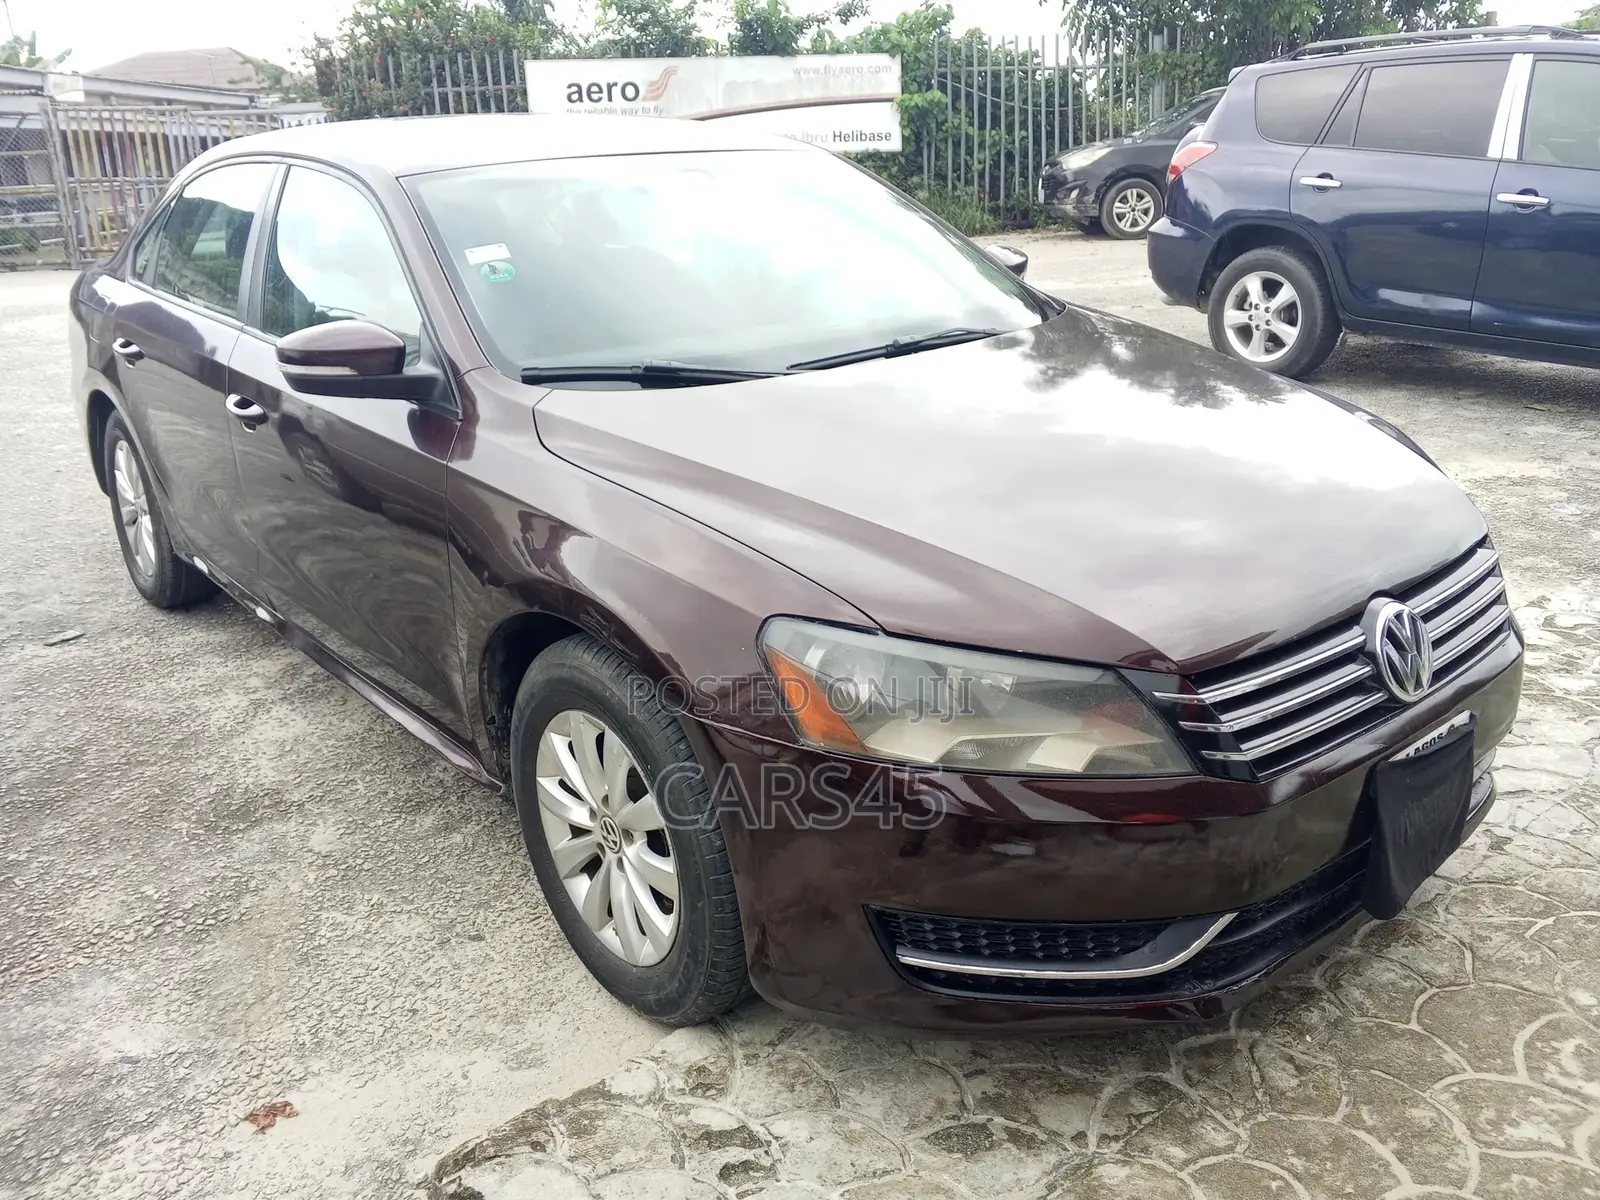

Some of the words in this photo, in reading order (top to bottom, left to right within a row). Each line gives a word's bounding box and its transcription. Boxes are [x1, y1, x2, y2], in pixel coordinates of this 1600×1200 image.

[792, 64, 892, 77] www.flyaero.com
[566, 81, 640, 103] aero
[620, 107, 640, 117] way
[641, 106, 651, 115] to
[832, 130, 892, 143] Helibase
